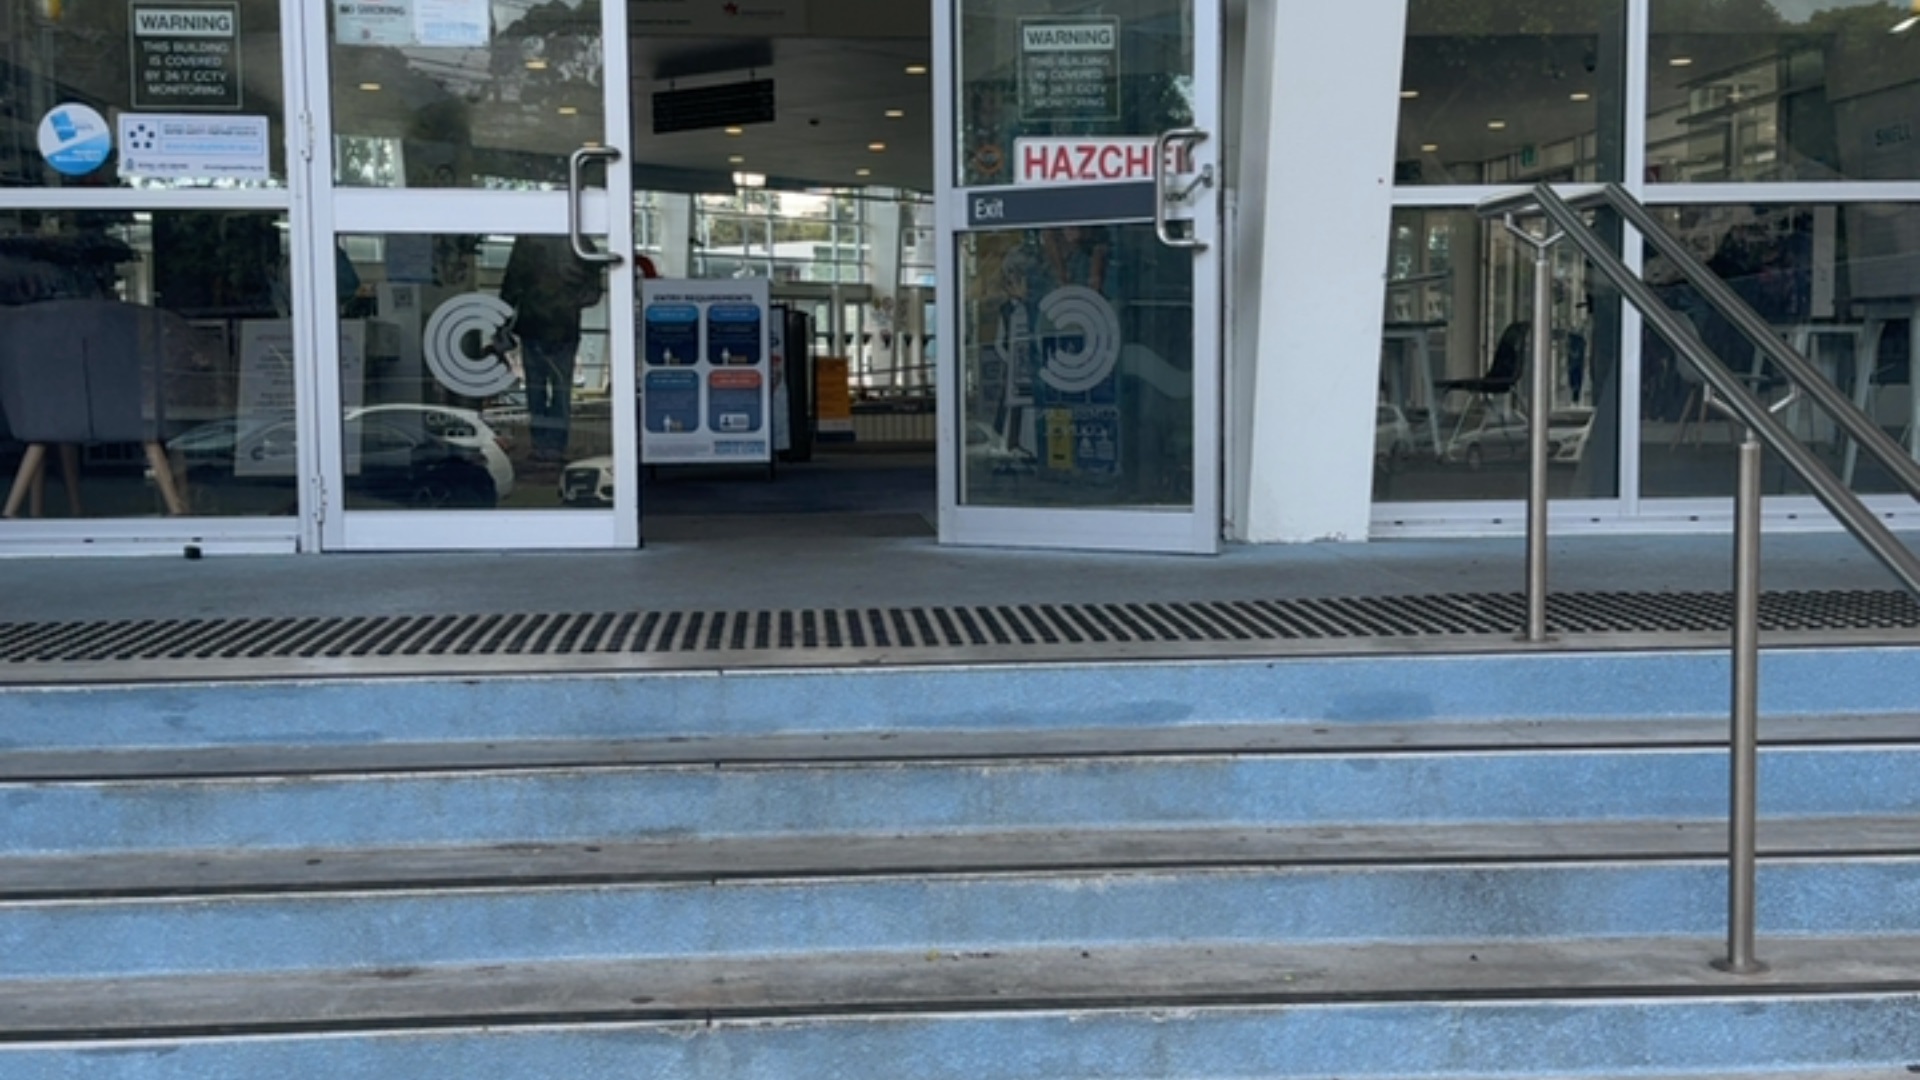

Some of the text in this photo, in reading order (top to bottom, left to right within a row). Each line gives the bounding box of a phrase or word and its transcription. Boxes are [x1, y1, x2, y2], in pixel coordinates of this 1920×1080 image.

[139, 14, 230, 31] WARNING
[1024, 29, 1111, 45] WARNING
[142, 41, 229, 53] THIS BUILDING
[149, 54, 222, 67] IS COVERED
[1028, 55, 1110, 68] THIS BUILDING
[144, 70, 160, 82] BY
[193, 70, 227, 82] CCTV
[1050, 68, 1103, 81] COVERED
[148, 84, 225, 96] MONITORING
[1076, 83, 1108, 95] CCTV
[1034, 97, 1105, 109] MONITORING
[974, 199, 1004, 219] Exit
